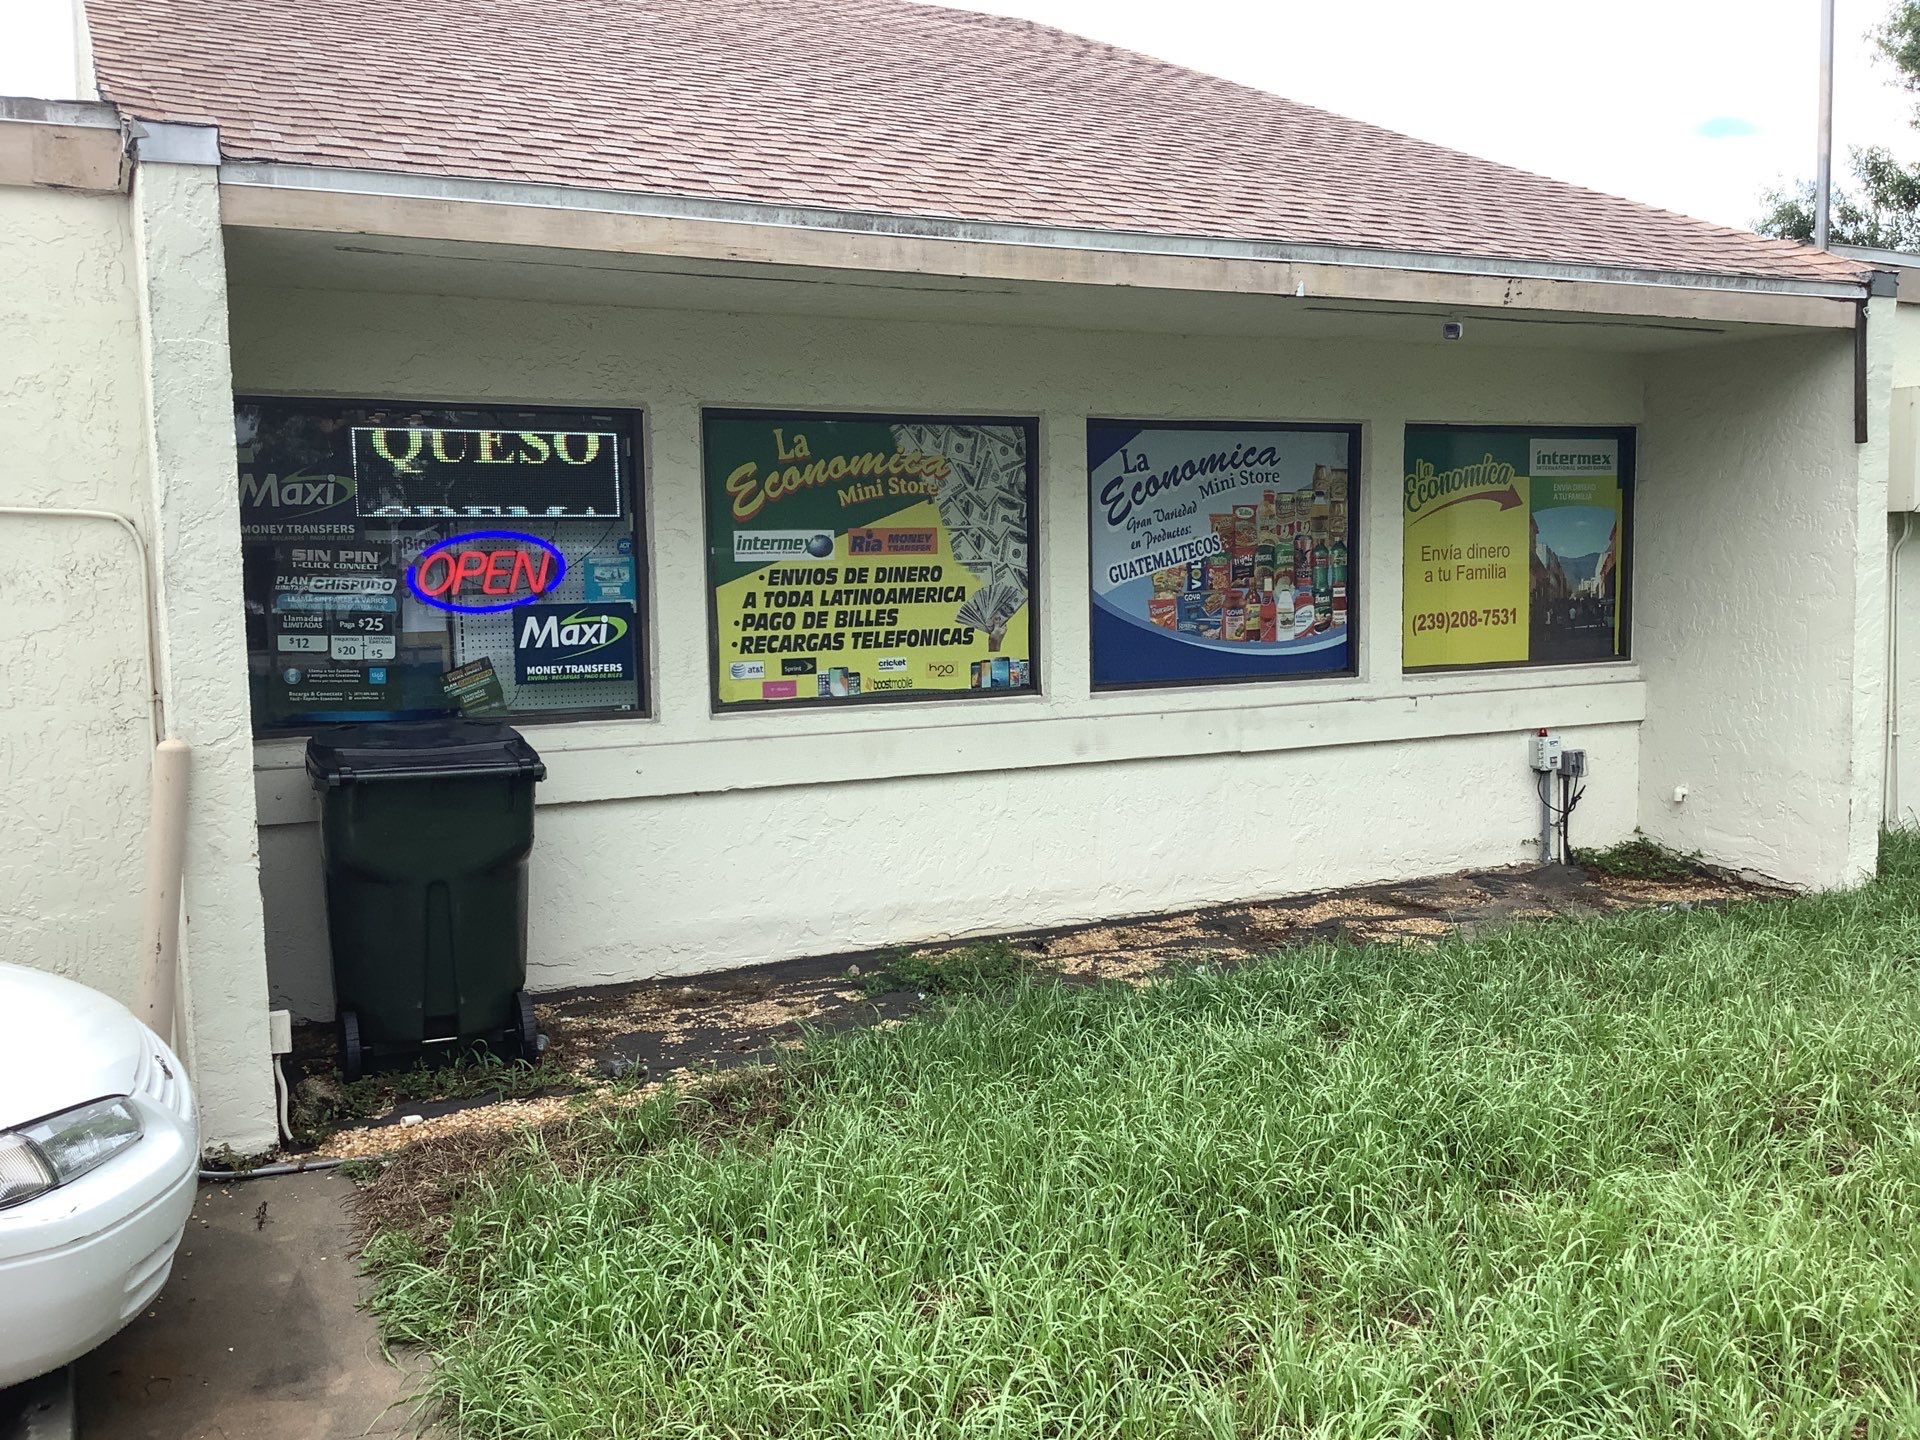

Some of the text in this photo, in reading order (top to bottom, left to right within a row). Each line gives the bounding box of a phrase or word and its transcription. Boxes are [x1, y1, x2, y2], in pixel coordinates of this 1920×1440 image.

[372, 429, 600, 473] QUESO
[773, 428, 811, 461] La
[1120, 448, 1150, 474] La
[1417, 460, 1433, 482] La
[239, 473, 335, 508] Maxi
[725, 446, 950, 521] Economica
[837, 477, 939, 507] Mini Store
[1100, 443, 1281, 527] Economica
[1198, 470, 1280, 500] Mini Store
[1405, 454, 1514, 512] Economica
[1127, 516, 1152, 534] Gran
[1153, 500, 1198, 523] Variedad
[241, 524, 355, 534] MONEY TRANSFERS
[888, 533, 932, 544] MONEY
[1131, 525, 1192, 550] en Productos:
[851, 530, 883, 553] Ria
[1421, 543, 1510, 561] Envía dinero
[291, 549, 378, 563] SIN PIN
[292, 561, 379, 570] 1-CLICK CONNECT
[1109, 534, 1221, 583] GUATEMALTECOS
[276, 576, 308, 585] PLAN
[418, 550, 552, 597] OPEN
[768, 565, 943, 586] ENVIOS DE DINERO
[1425, 563, 1506, 582] a tu Familia
[313, 579, 393, 591] CHISPUDO
[742, 586, 966, 609] A TODA LATINOAMERICA
[339, 617, 384, 631] Paga $25
[741, 608, 899, 631] PAGO DE BILLES
[1412, 608, 1517, 636] (239)208-7531
[289, 637, 310, 649] $12
[519, 614, 608, 649] Maxi
[739, 627, 975, 654] RECARGAS TELEFONICAS
[337, 646, 356, 655] $20
[371, 649, 383, 658] $5
[878, 658, 907, 666] cricket
[526, 663, 623, 675] MONEY TRANSFERS
